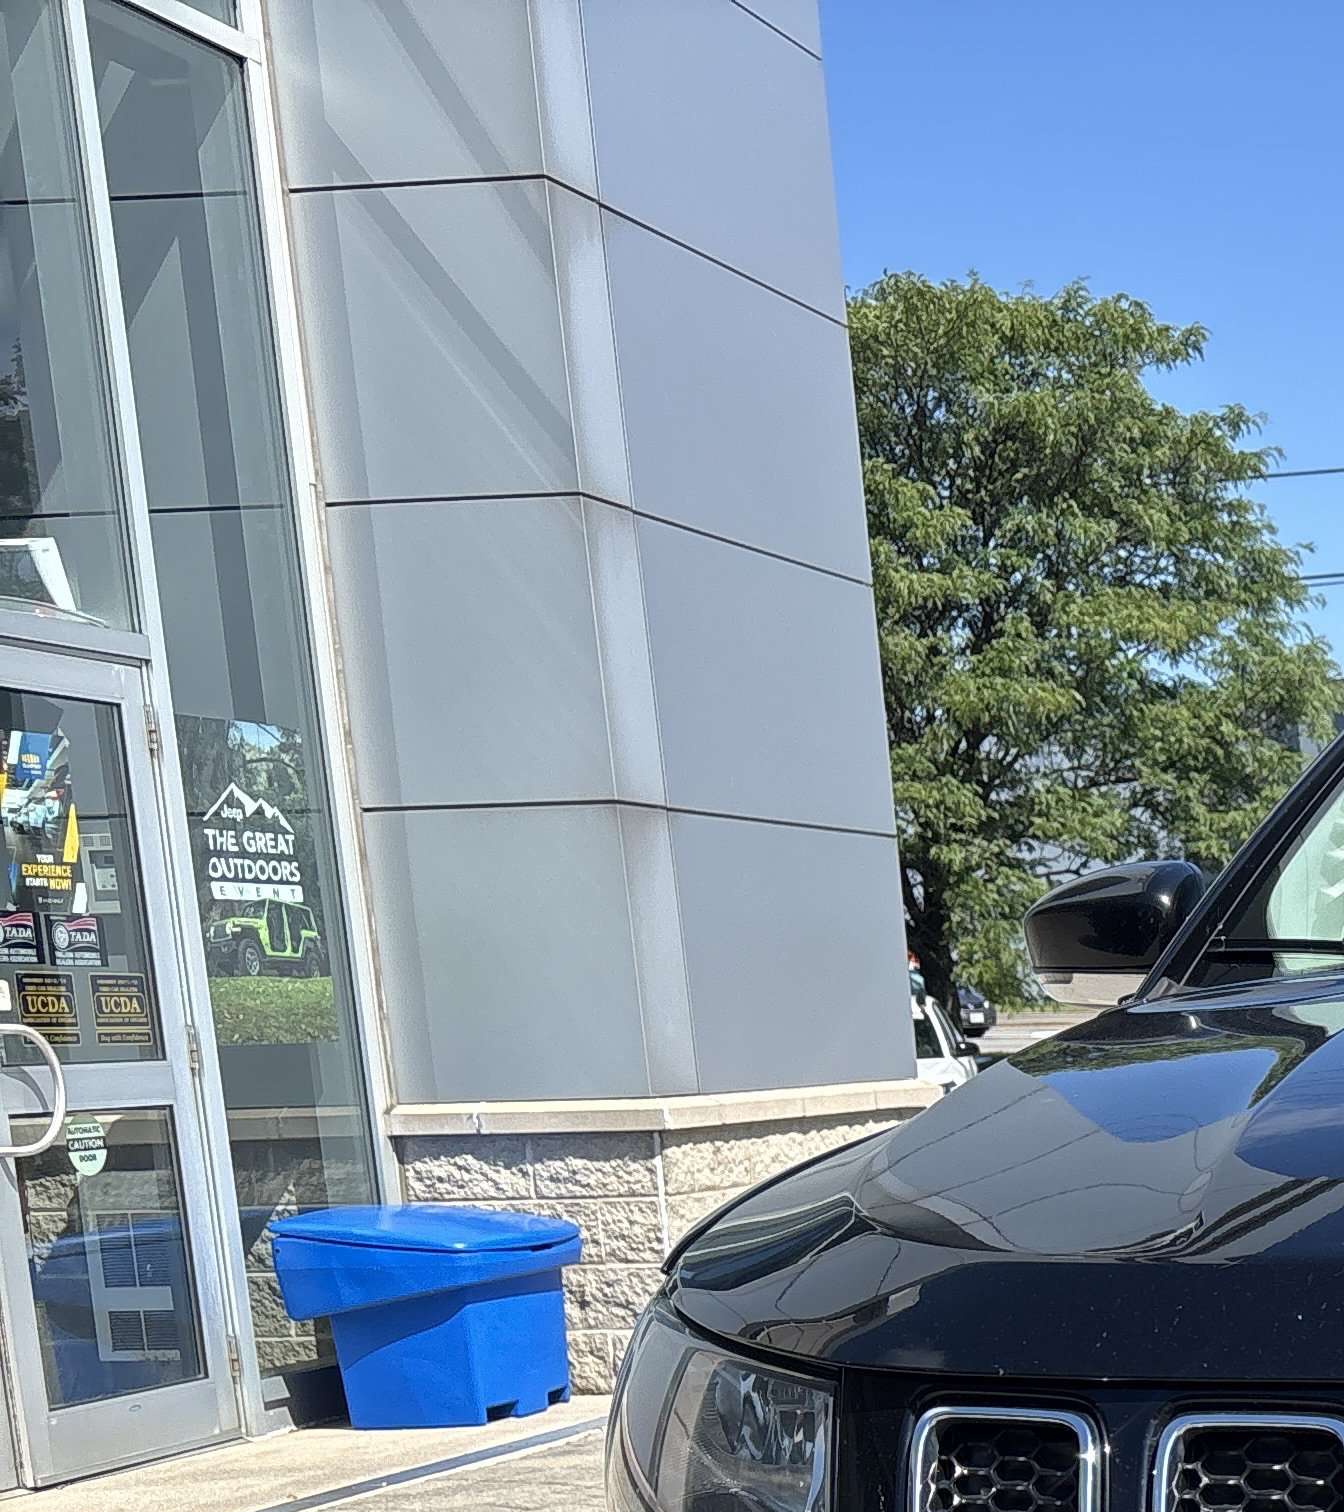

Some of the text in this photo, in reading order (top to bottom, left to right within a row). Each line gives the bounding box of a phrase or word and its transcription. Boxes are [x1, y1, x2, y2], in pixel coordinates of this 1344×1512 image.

[220, 804, 243, 821] Jeep
[204, 828, 295, 855] THE GREAT
[21, 863, 72, 877] EXPERIENCE
[208, 857, 301, 882] OUTDOORS
[219, 885, 297, 899] EVENT
[4, 926, 33, 938] TADA
[70, 931, 97, 942] TADA
[26, 995, 70, 1013] UCDA
[100, 996, 142, 1013] UCDA
[68, 1138, 105, 1150] CAUTION
